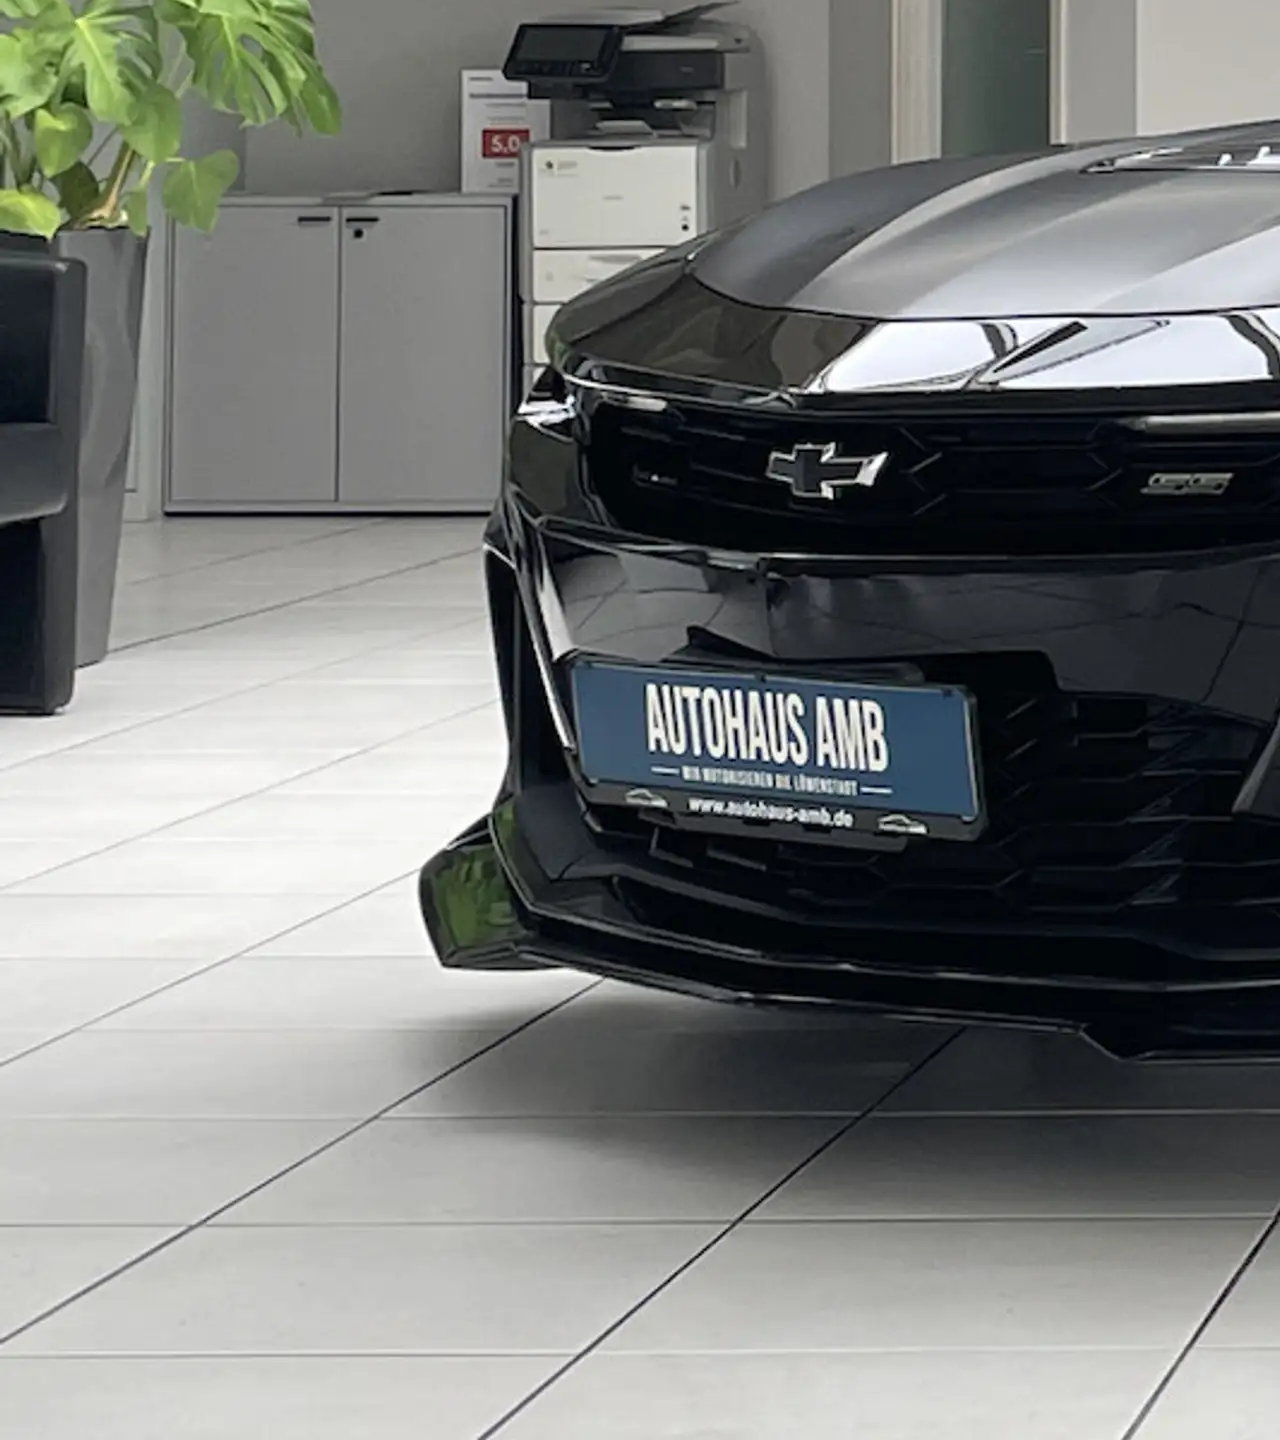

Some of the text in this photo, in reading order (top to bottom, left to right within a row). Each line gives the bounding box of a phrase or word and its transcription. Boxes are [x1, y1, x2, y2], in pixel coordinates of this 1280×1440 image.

[490, 136, 520, 153] 5.0
[646, 684, 887, 772] AUTOHAUS AMB
[688, 798, 853, 827] www.autohaus-amb.de
